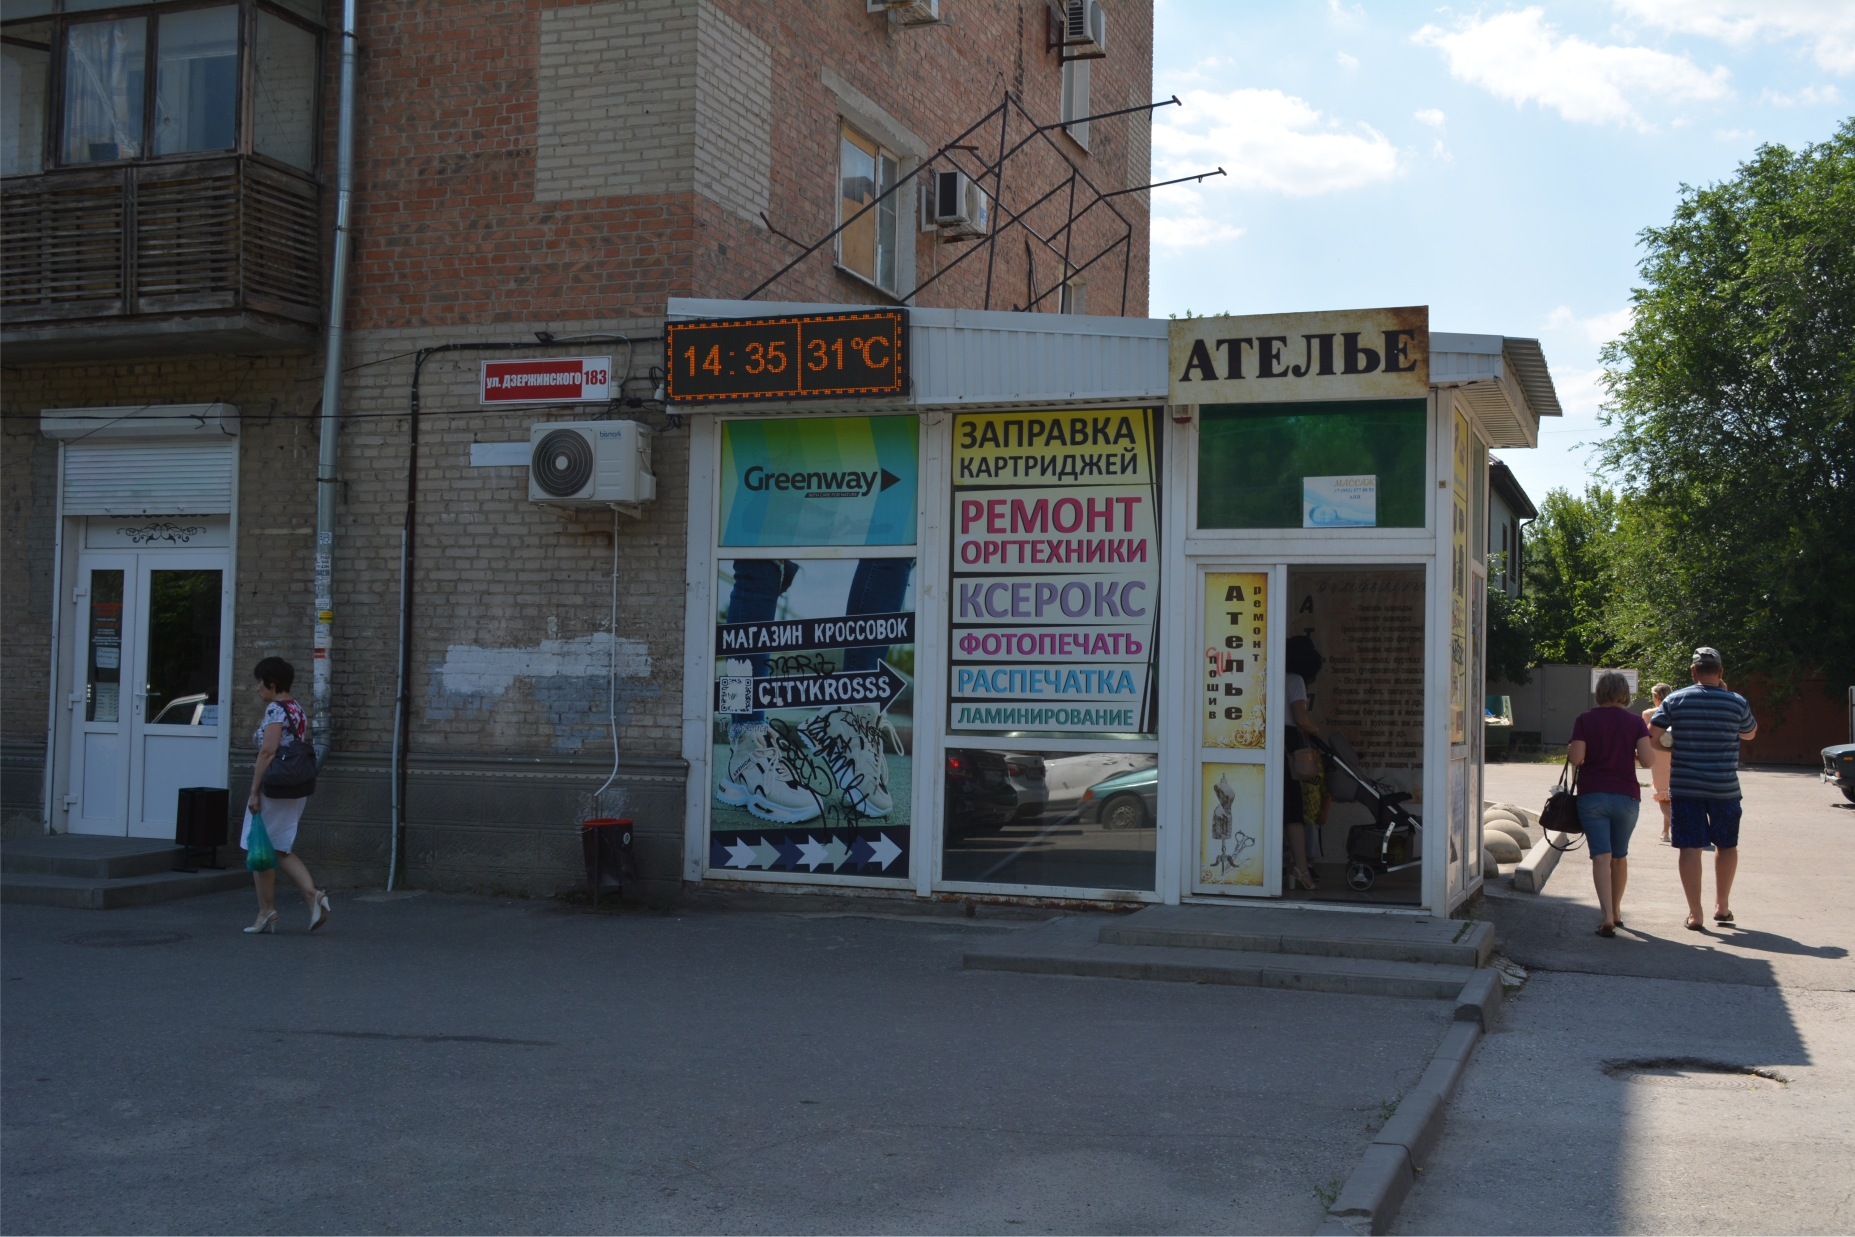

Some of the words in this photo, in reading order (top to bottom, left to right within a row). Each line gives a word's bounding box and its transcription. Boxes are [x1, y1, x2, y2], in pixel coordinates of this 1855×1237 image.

[1178, 329, 1418, 382] АТЕЛЬЕ
[486, 377, 501, 389] ул.
[502, 372, 582, 389] ДЗЕРЖИНСКОГО
[583, 369, 607, 386] 183
[960, 416, 1137, 449] ЗАПРАВКА
[959, 446, 1138, 481] КАРТРИДЖЕЙ
[744, 465, 878, 497] Greenway
[1334, 478, 1375, 487] МАССАЖ
[961, 497, 1142, 534] РЕМОНТ
[961, 538, 1147, 564] ОРГТЕХНИКИ
[959, 580, 1146, 618] КСЕРОКС
[1384, 605, 1412, 613] одежды
[722, 624, 803, 649] МАГАЗИН
[814, 617, 908, 643] КРОССОВОК
[1252, 585, 1264, 662] ремонт
[1383, 615, 1411, 623] одежды
[959, 633, 1143, 655] ФОТОПЕЧАТЬ
[1224, 585, 1245, 721] Ателье
[1396, 635, 1421, 645] фигуре
[758, 675, 891, 706] CITYKROSSS
[958, 668, 1137, 694] РАСПЕЧАТКА
[957, 707, 1134, 726] ЛАМИНИРОВАНИЕ
